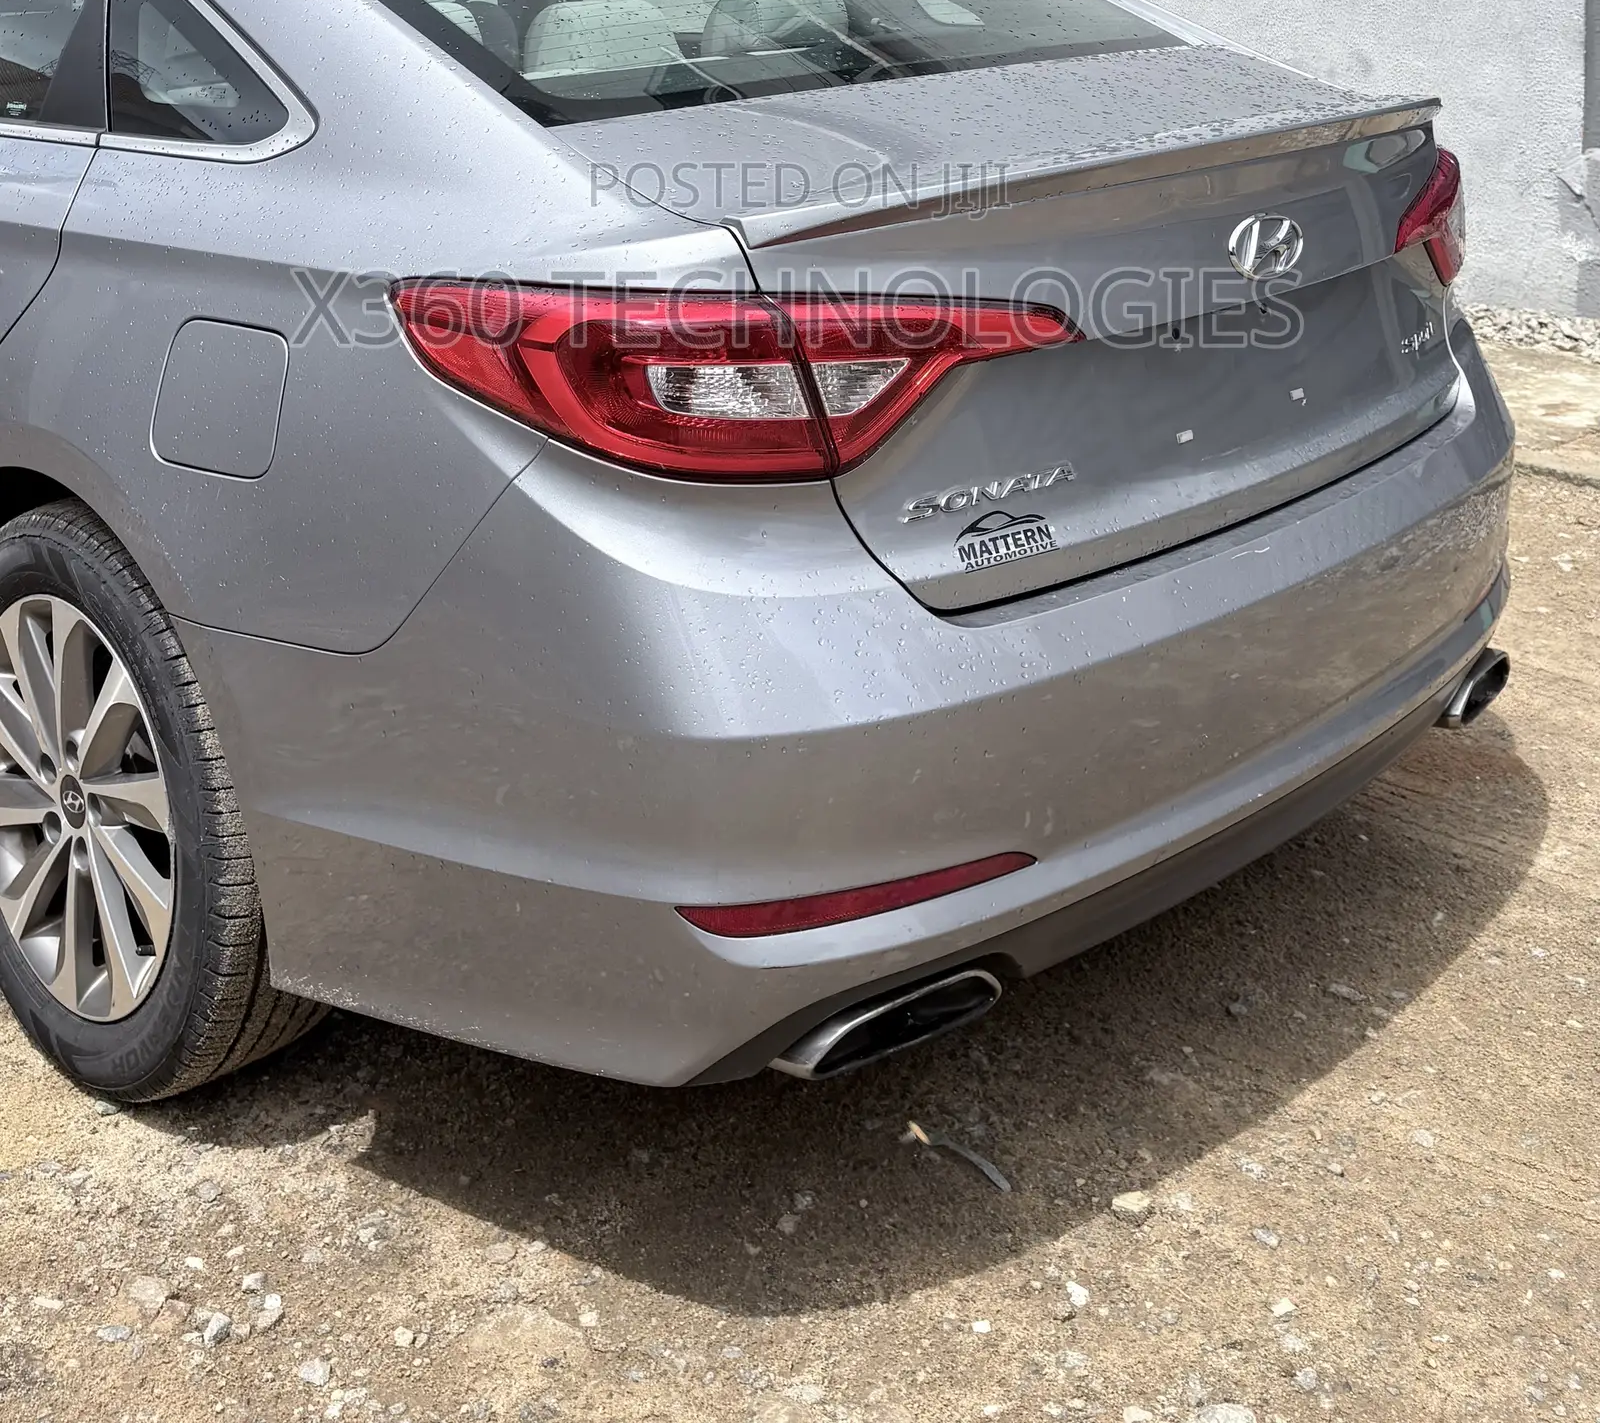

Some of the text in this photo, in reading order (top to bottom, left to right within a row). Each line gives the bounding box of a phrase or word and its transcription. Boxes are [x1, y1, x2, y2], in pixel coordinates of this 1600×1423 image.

[899, 462, 1077, 524] SONATA
[957, 524, 1053, 563] MATTERN
[964, 540, 1059, 571] AUTOMOTIVE
